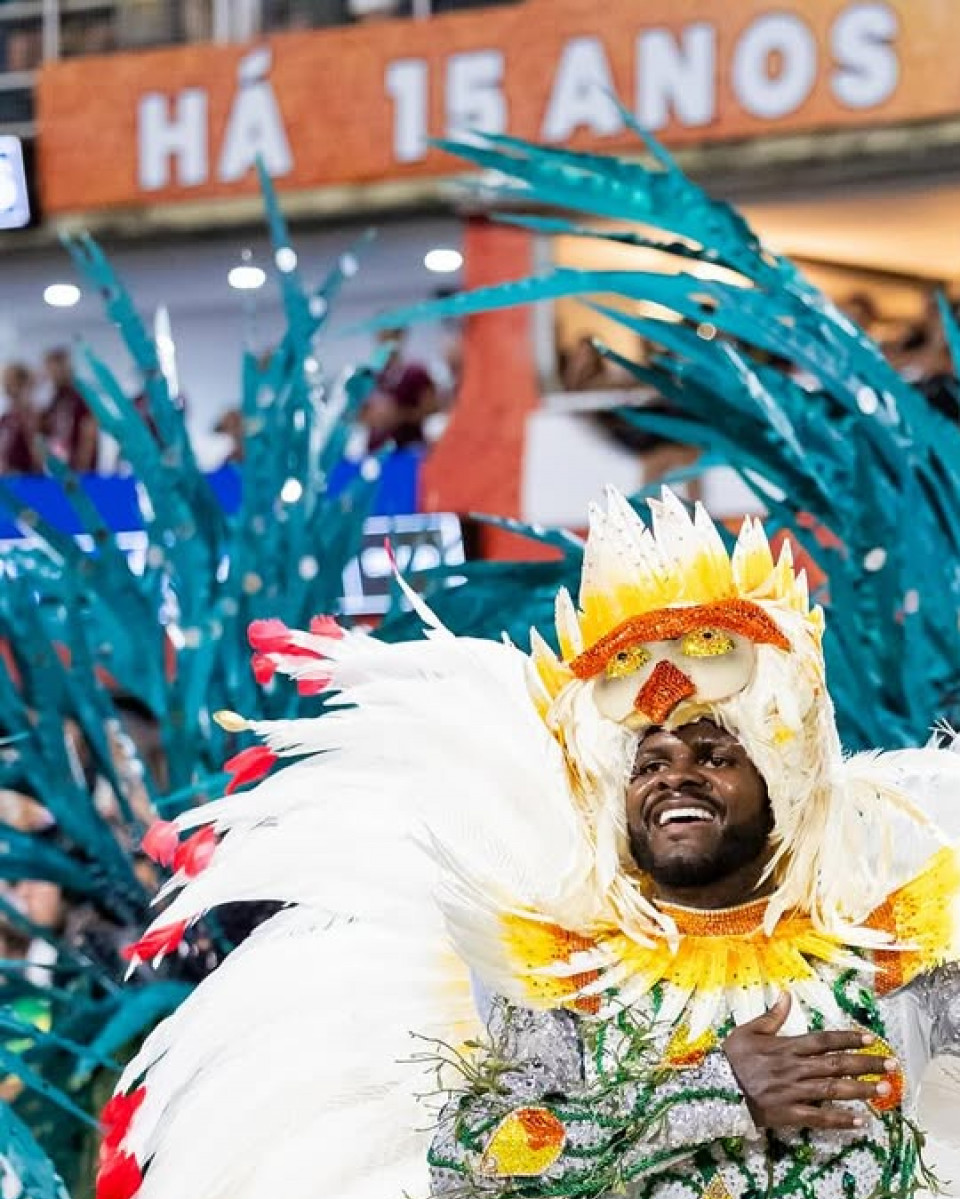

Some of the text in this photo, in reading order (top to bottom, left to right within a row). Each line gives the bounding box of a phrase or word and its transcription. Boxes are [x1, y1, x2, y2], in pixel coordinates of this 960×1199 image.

[138, 2, 899, 190] HÁ 15 ANOS
